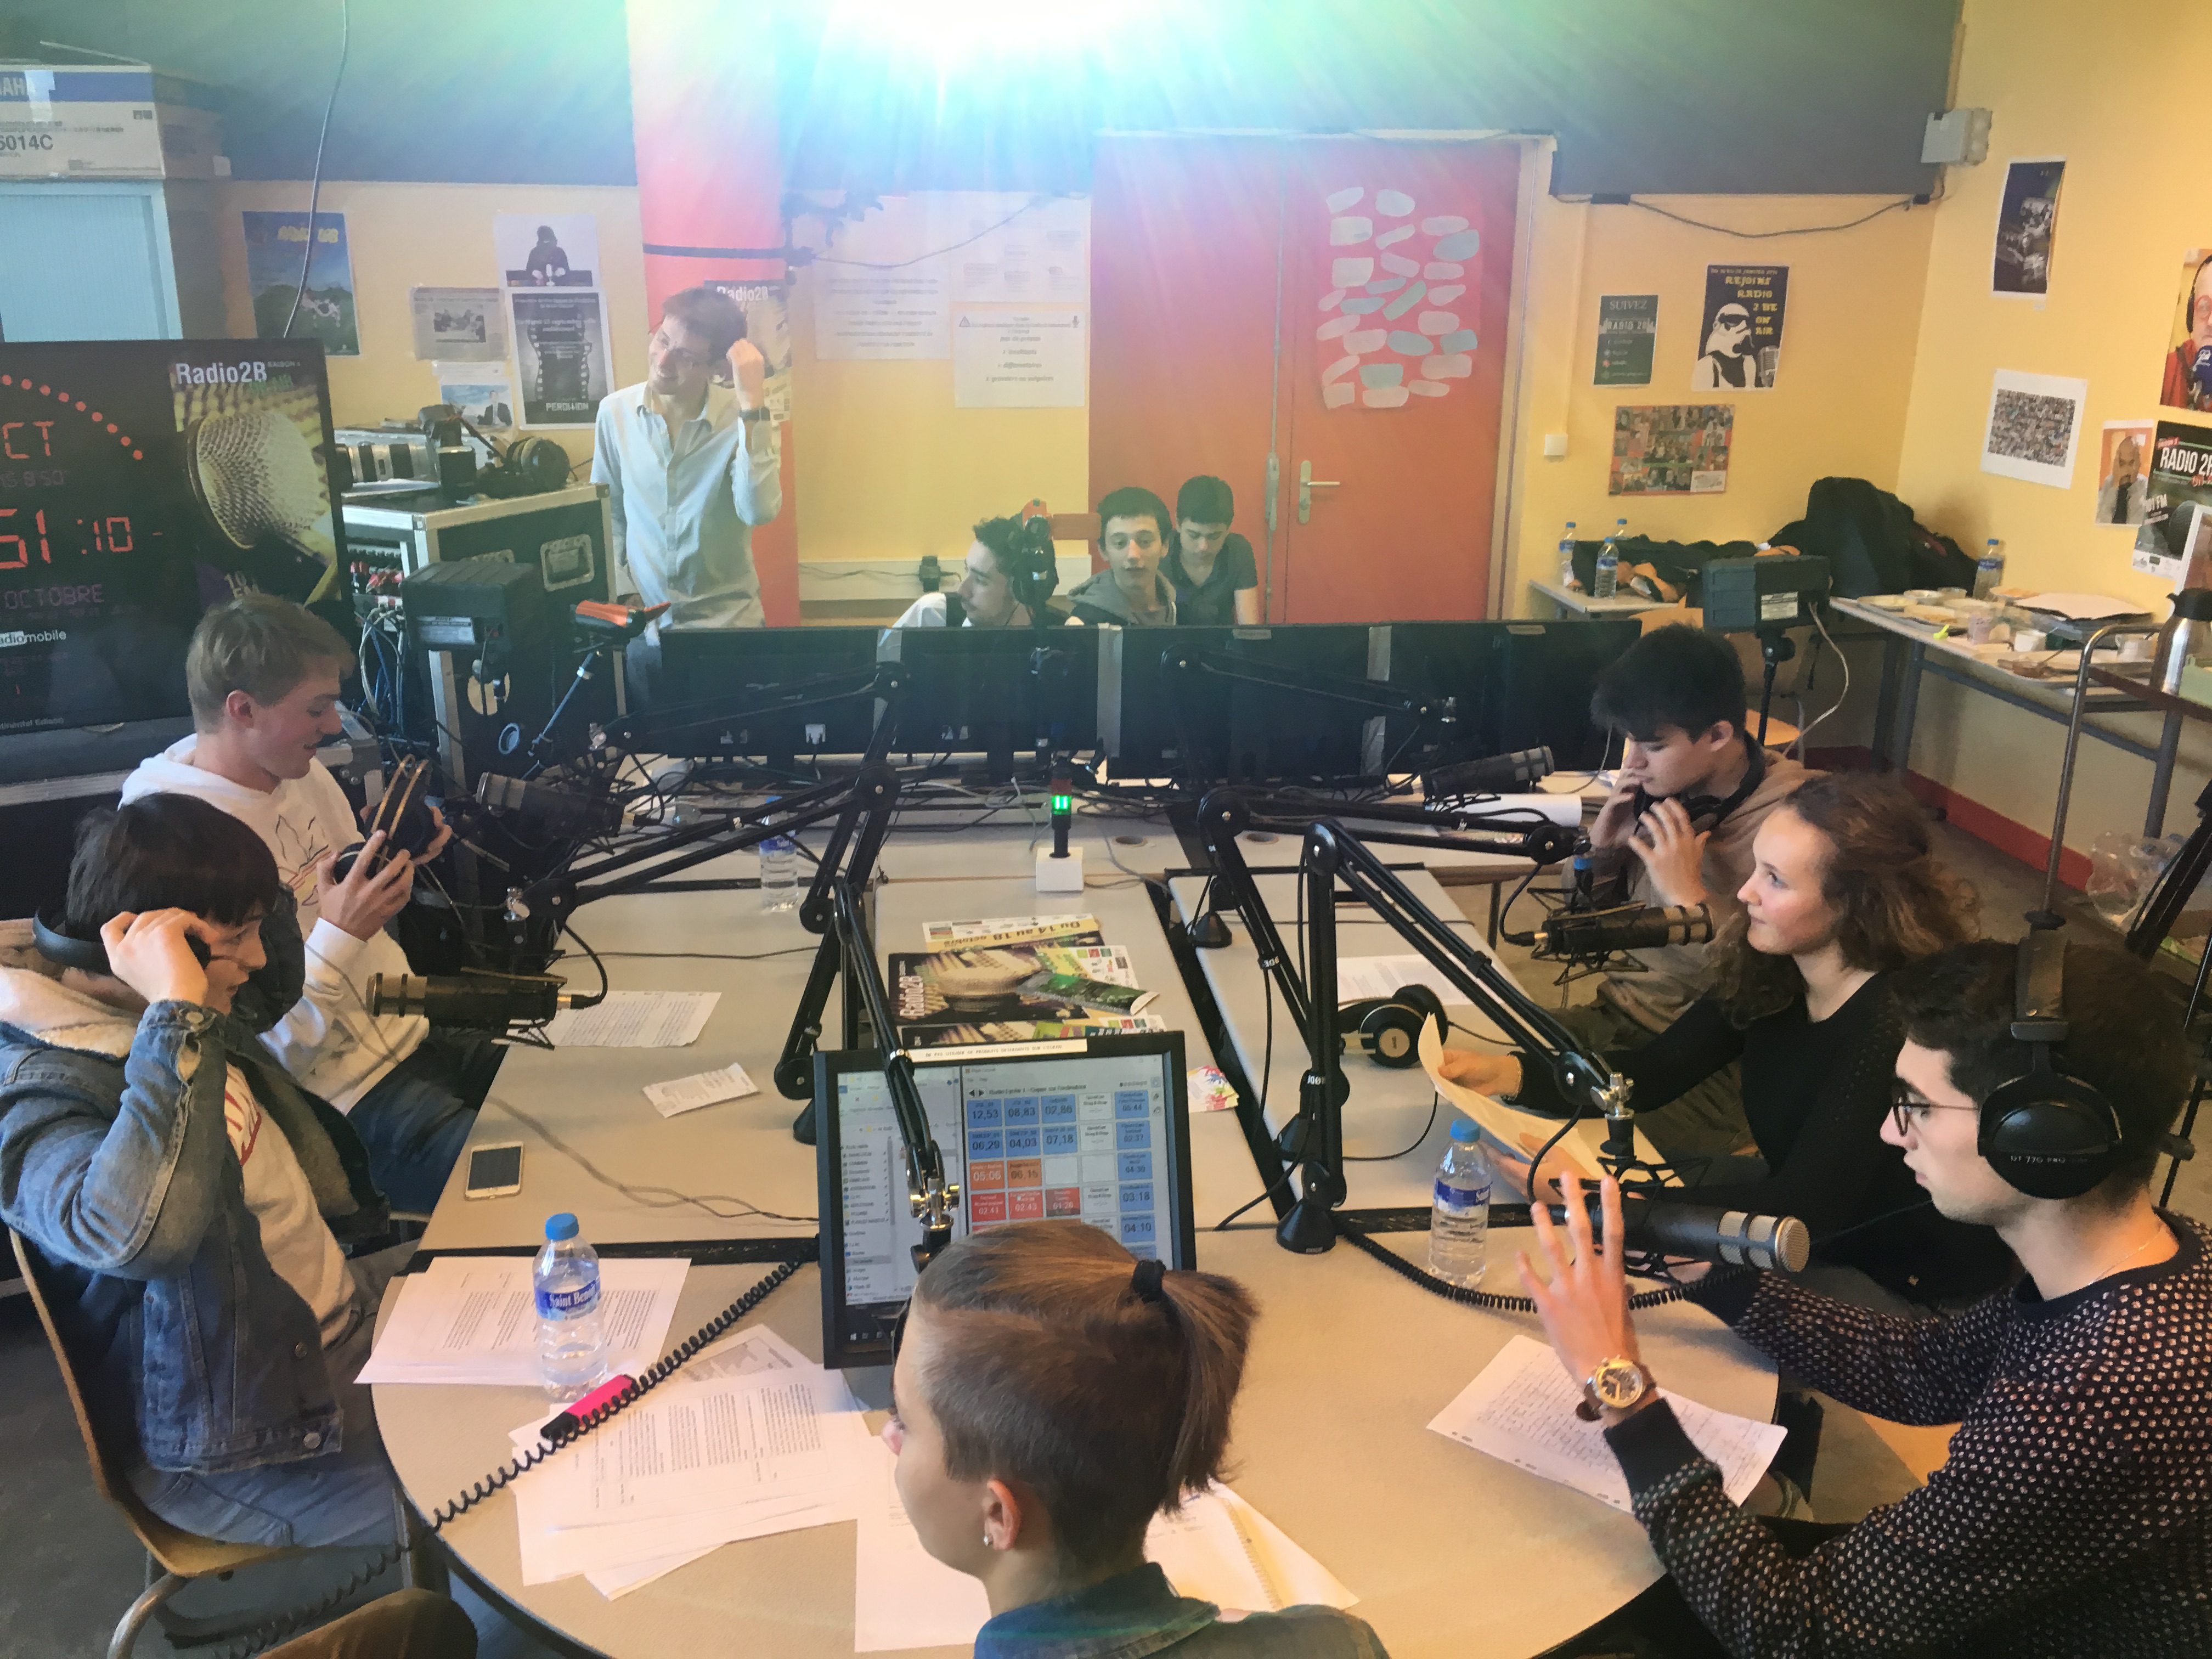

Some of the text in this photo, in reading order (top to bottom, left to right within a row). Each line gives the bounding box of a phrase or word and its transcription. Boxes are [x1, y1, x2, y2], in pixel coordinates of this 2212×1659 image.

[1737, 290, 1773, 298] RADIO
[1610, 300, 1647, 311] SUIVEZ
[176, 362, 268, 384] Radio2B
[2159, 447, 2198, 474] RADIO
[4, 584, 104, 610] OCTOBRE
[899, 975, 926, 1017] Radio2B
[972, 1109, 998, 1120] 12,53
[1046, 1134, 1074, 1146] 07,18
[549, 1293, 572, 1308] Saint
